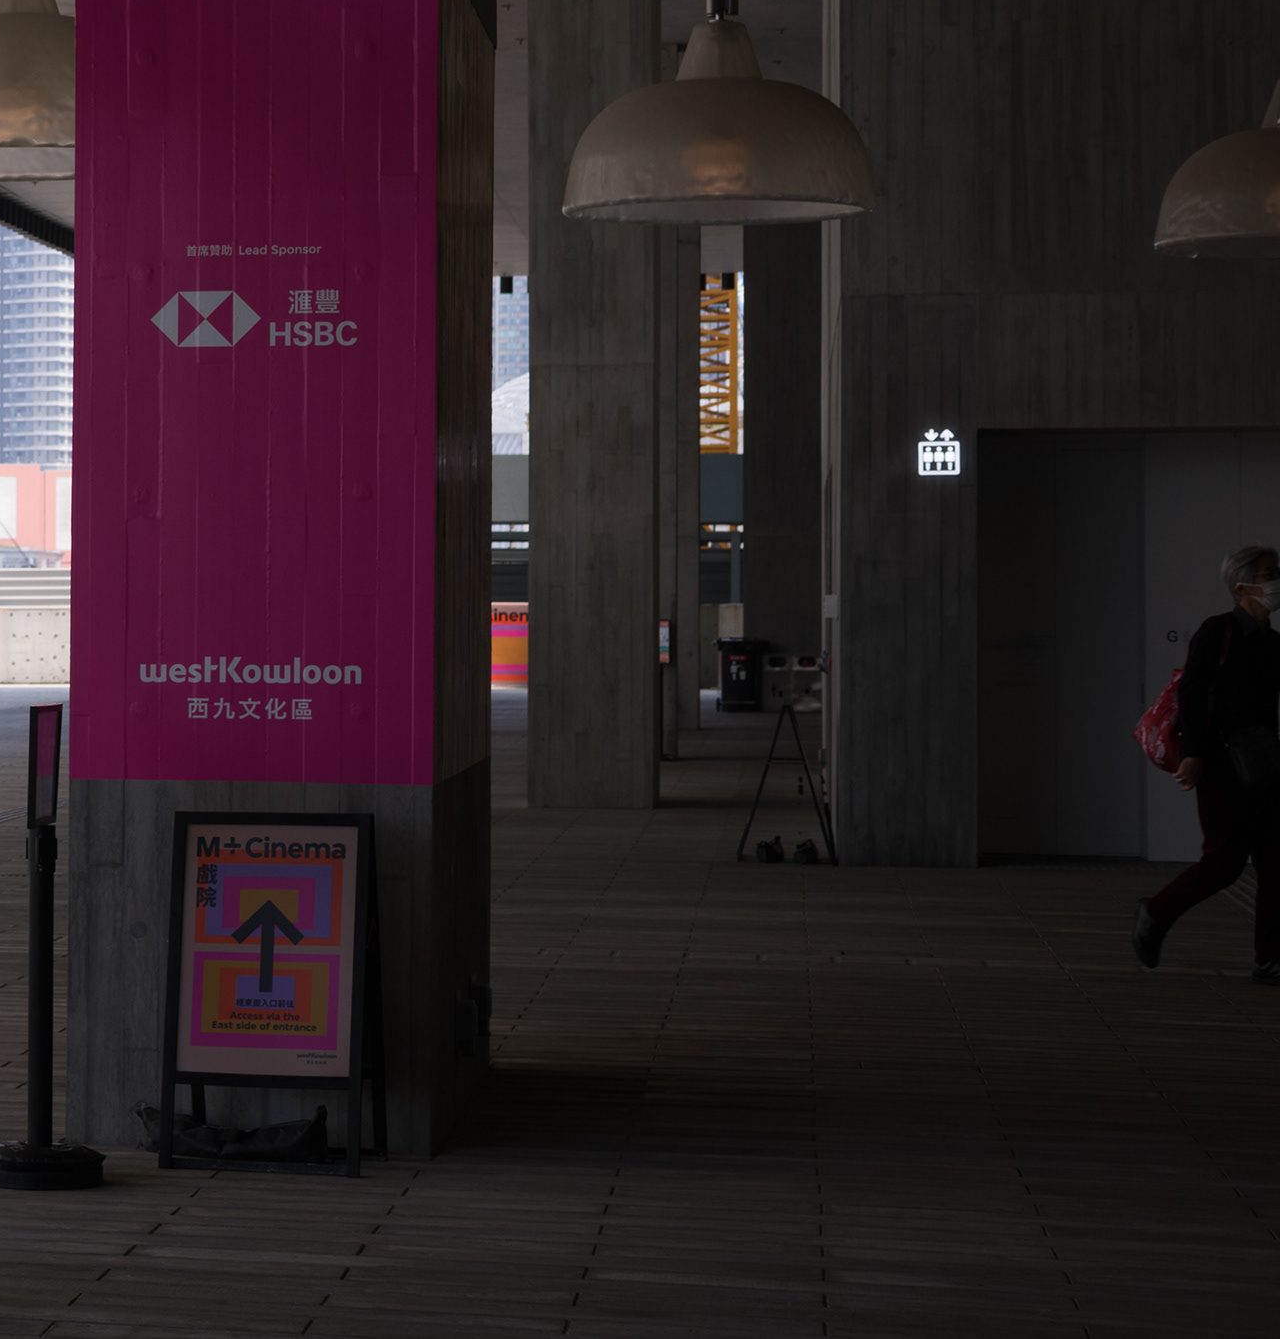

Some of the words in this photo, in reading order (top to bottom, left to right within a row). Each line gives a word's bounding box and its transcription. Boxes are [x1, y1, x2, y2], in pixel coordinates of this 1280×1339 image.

[239, 245, 268, 255] Lead
[271, 244, 322, 257] Sponsor
[269, 320, 358, 347] HSBC
[140, 656, 362, 685] westKowloon
[187, 697, 313, 720] 西九文化區
[245, 837, 347, 860] Cinema
[212, 1021, 233, 1029] East
[236, 1021, 256, 1030] side
[259, 1022, 271, 1030] of
[273, 1023, 317, 1032] entrance
[230, 1011, 264, 1021] Access
[266, 1012, 280, 1021] via
[283, 1013, 300, 1022] the
